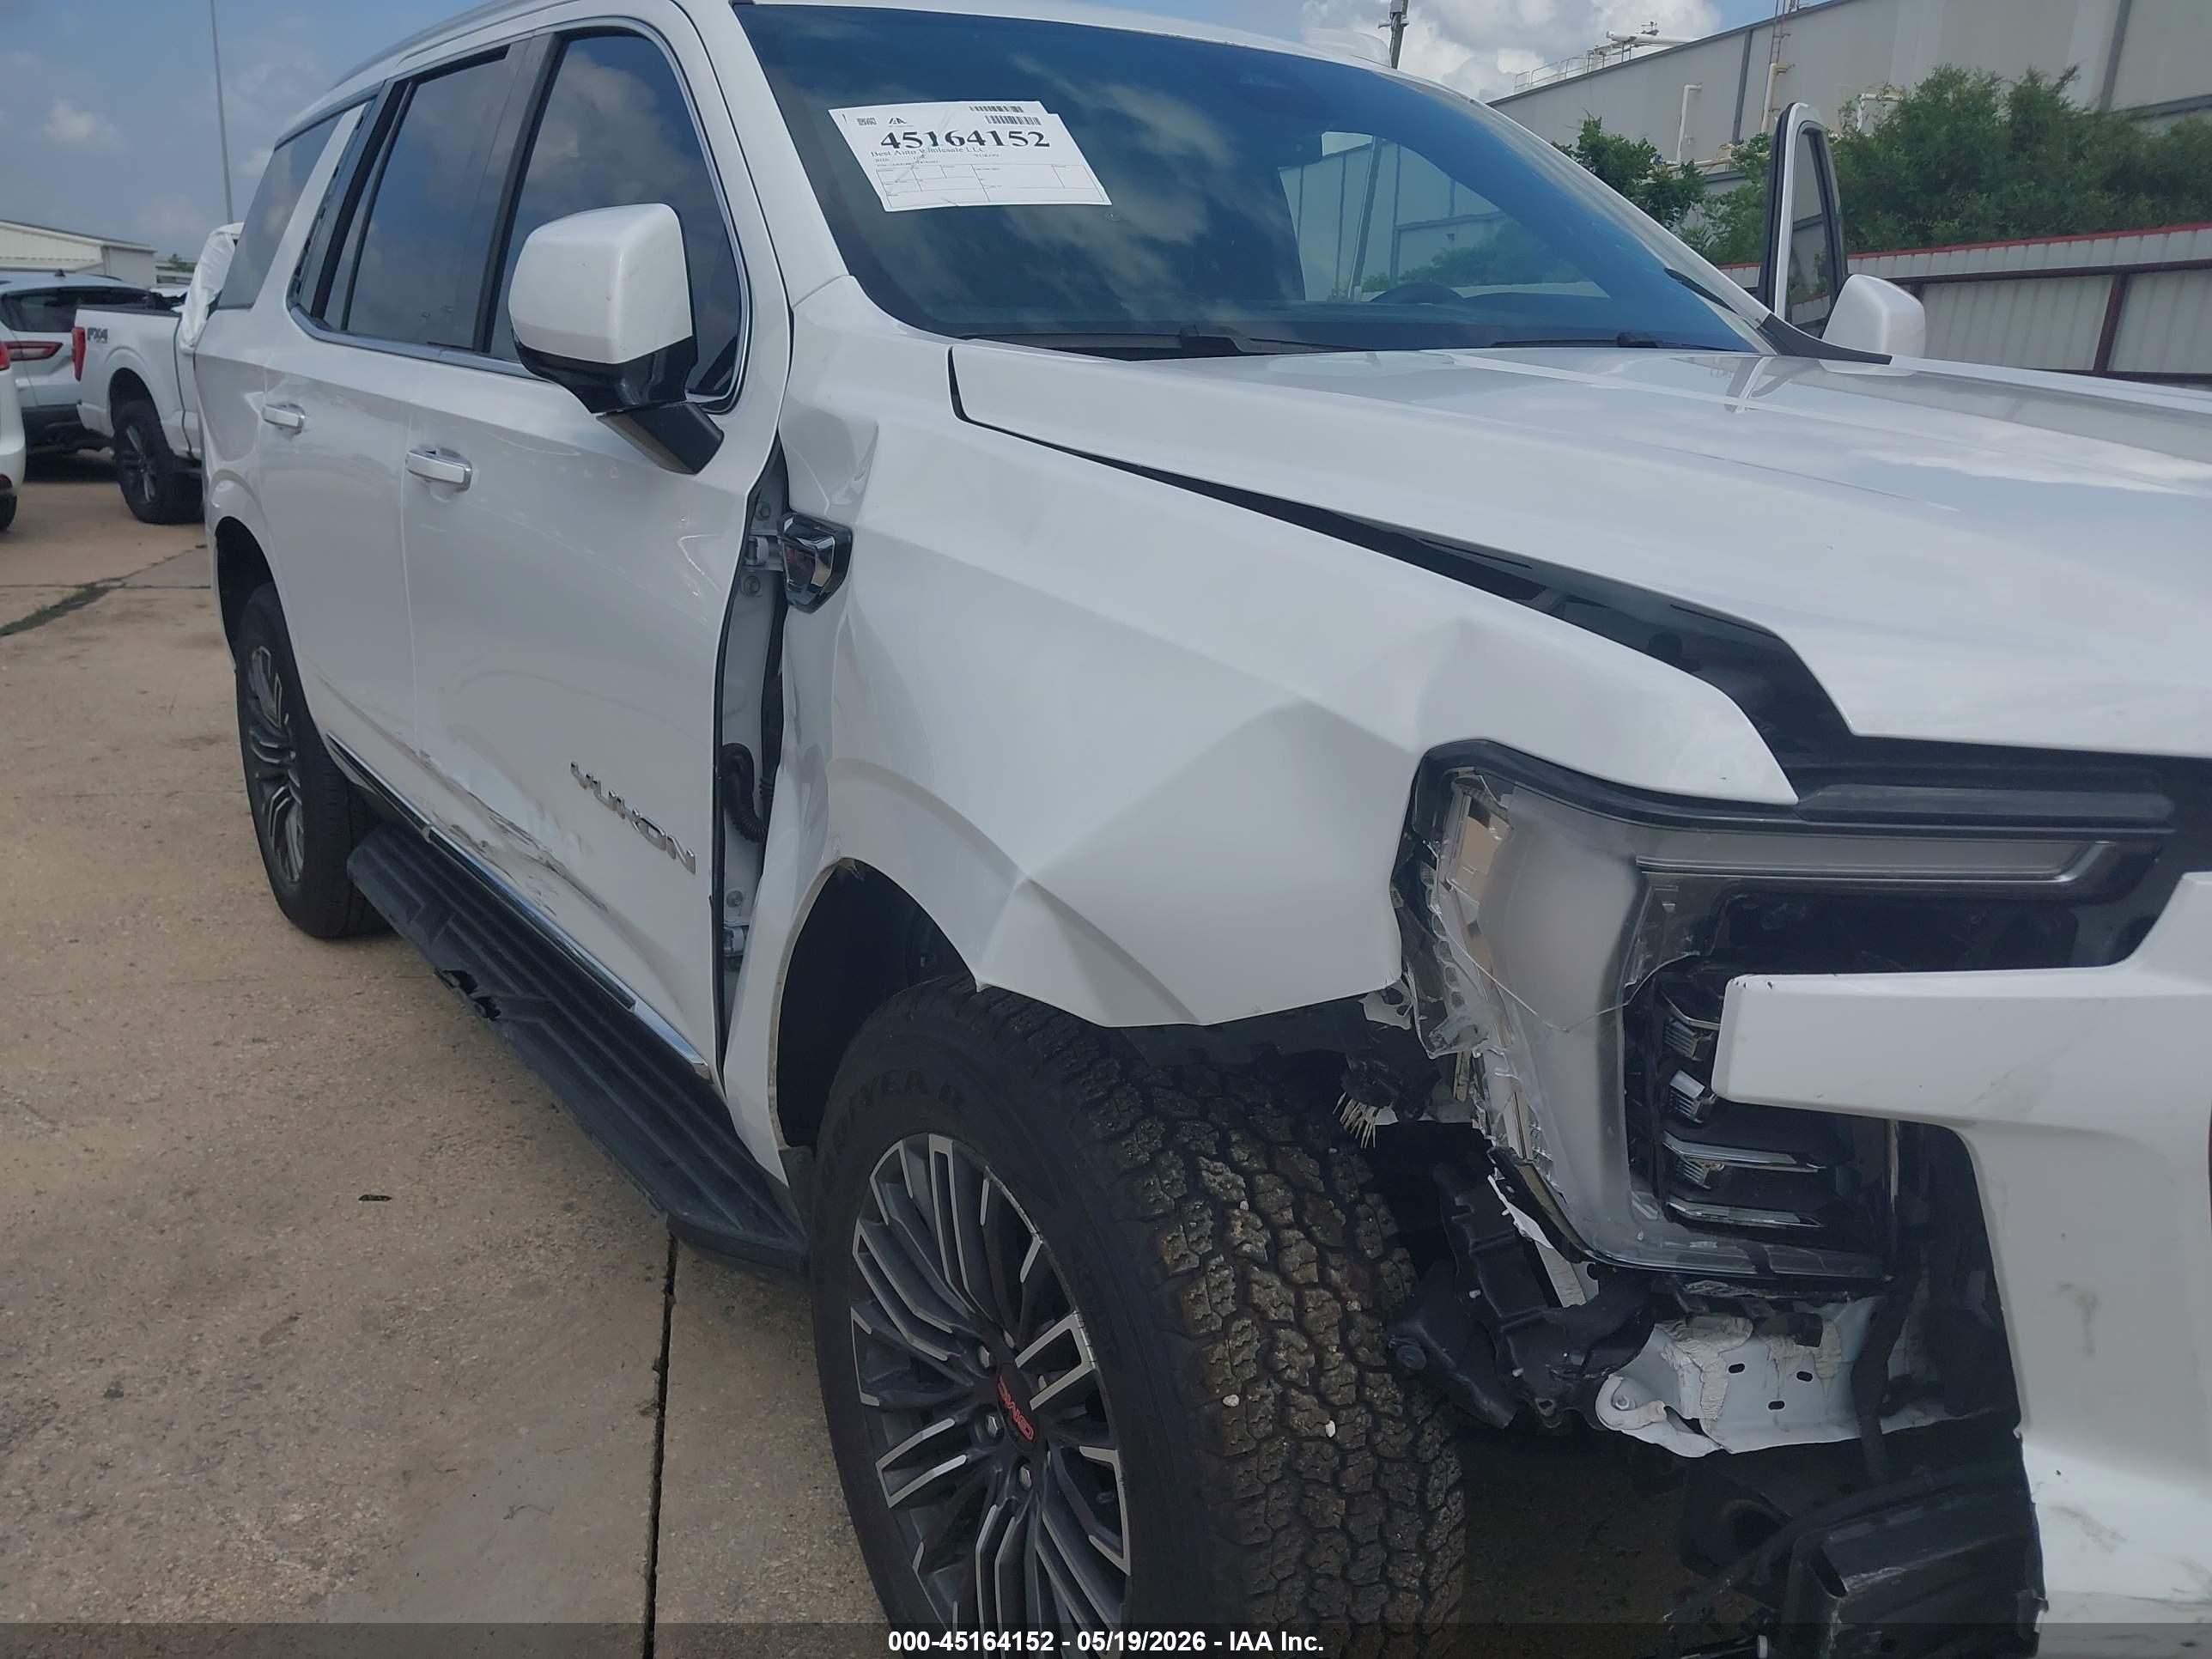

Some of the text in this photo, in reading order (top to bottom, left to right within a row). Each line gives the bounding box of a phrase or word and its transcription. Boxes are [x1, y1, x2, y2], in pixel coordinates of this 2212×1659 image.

[880, 130, 1050, 149] 45164152
[87, 326, 108, 342] FX4
[570, 761, 696, 875] YUKON
